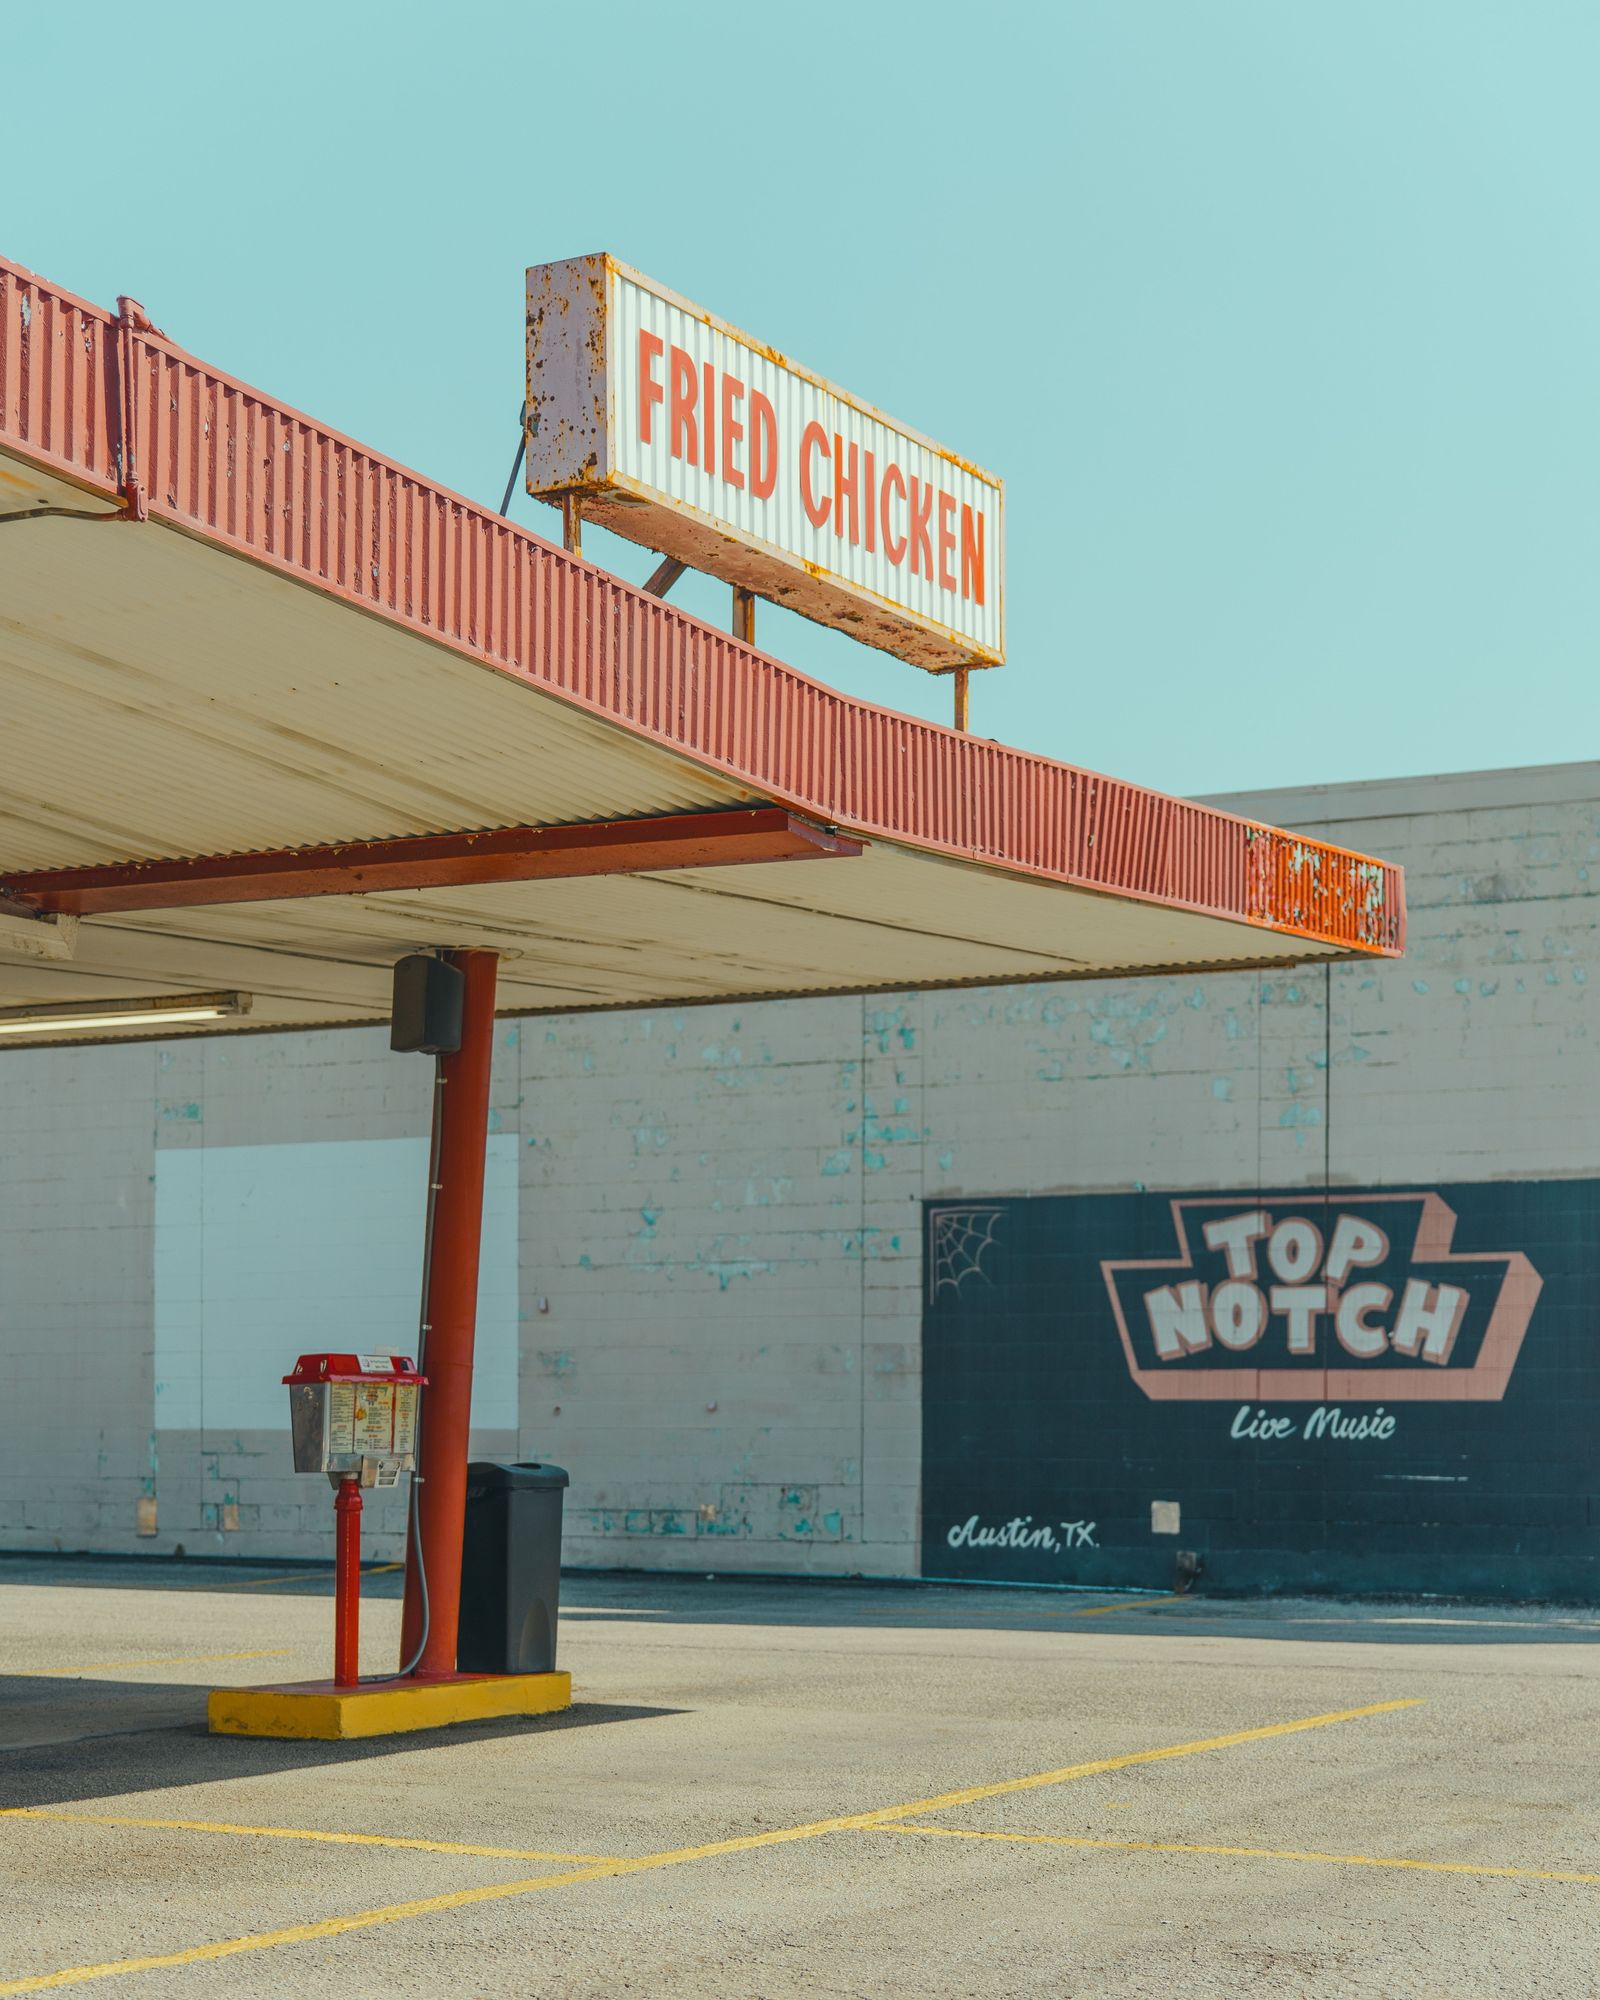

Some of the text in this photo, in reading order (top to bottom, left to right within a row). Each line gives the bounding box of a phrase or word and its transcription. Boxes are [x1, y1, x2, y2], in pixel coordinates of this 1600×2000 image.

[639, 328, 985, 606] FRIED CHICKEN
[1202, 1210, 1389, 1286] TOP
[1144, 1278, 1470, 1366] NOTCH
[1230, 1405, 1396, 1440] Live Music
